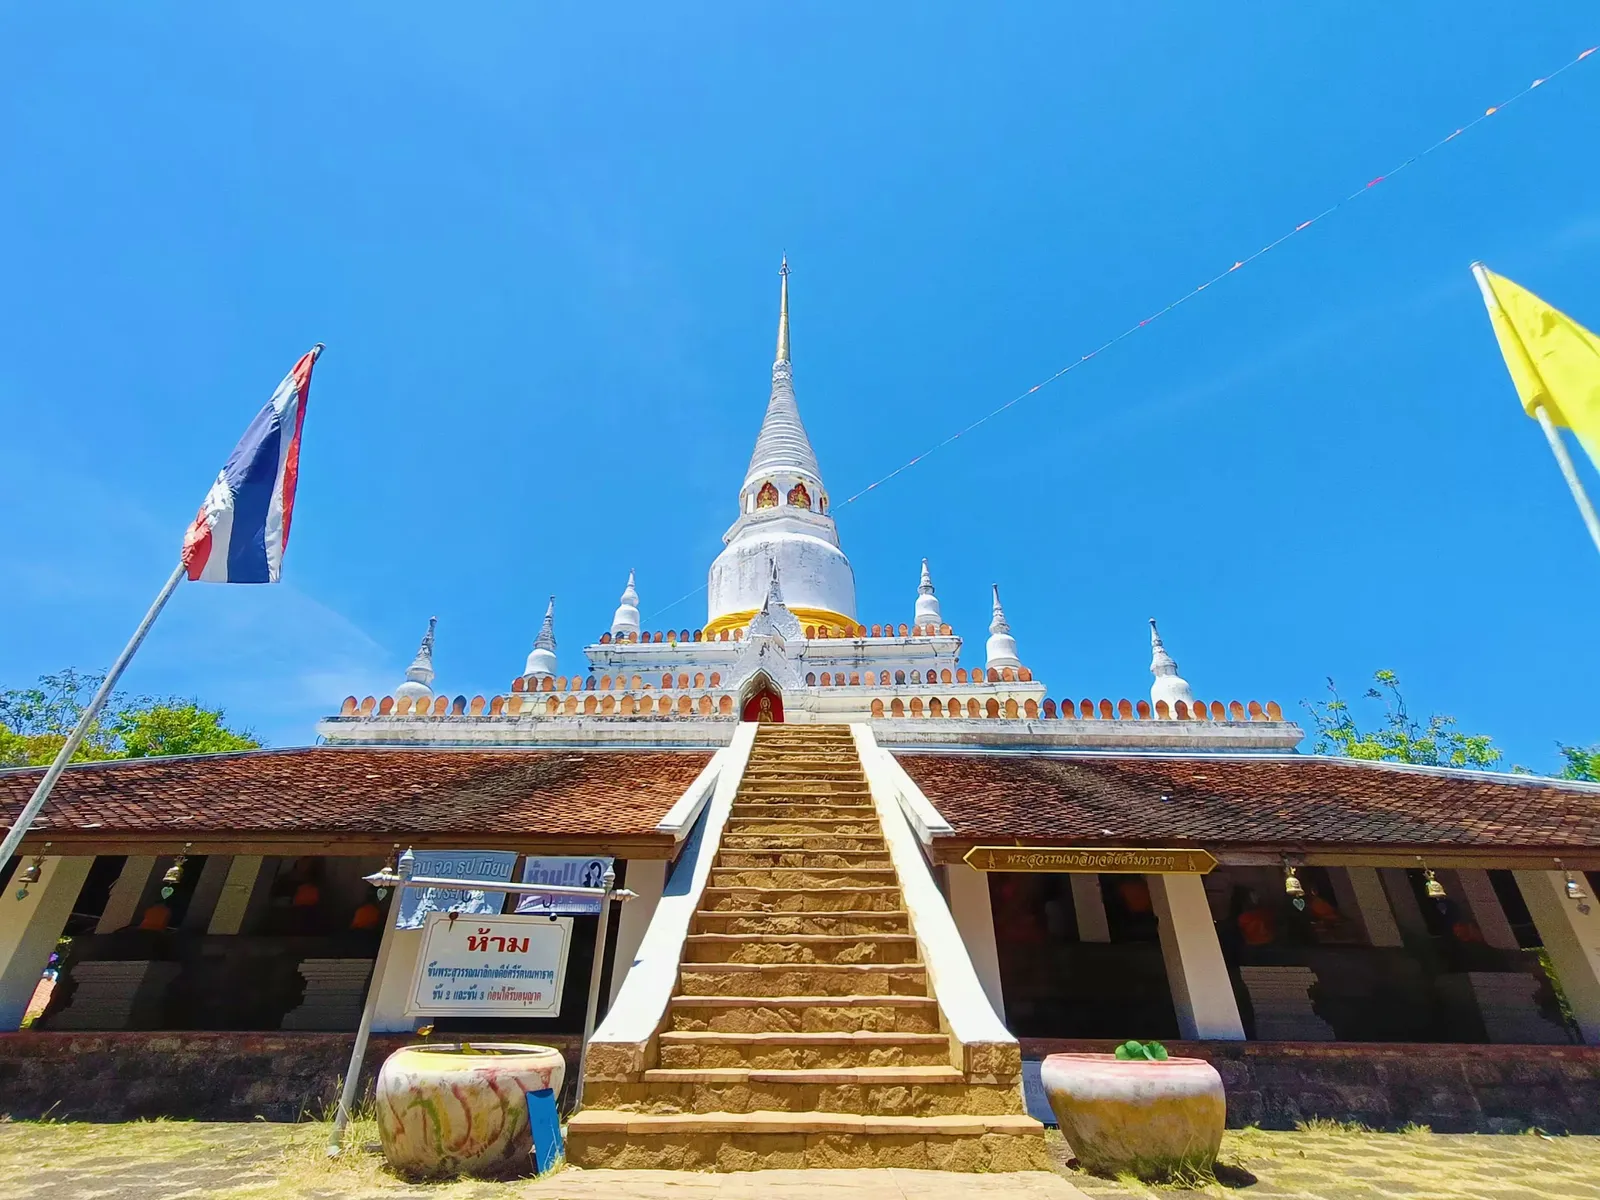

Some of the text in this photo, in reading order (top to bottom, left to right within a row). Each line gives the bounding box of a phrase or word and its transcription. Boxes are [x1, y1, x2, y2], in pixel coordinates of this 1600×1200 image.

[477, 857, 510, 878] เทียน
[466, 927, 530, 954] ห้าม
[445, 990, 451, 1000] 2
[479, 990, 485, 1000] 3
